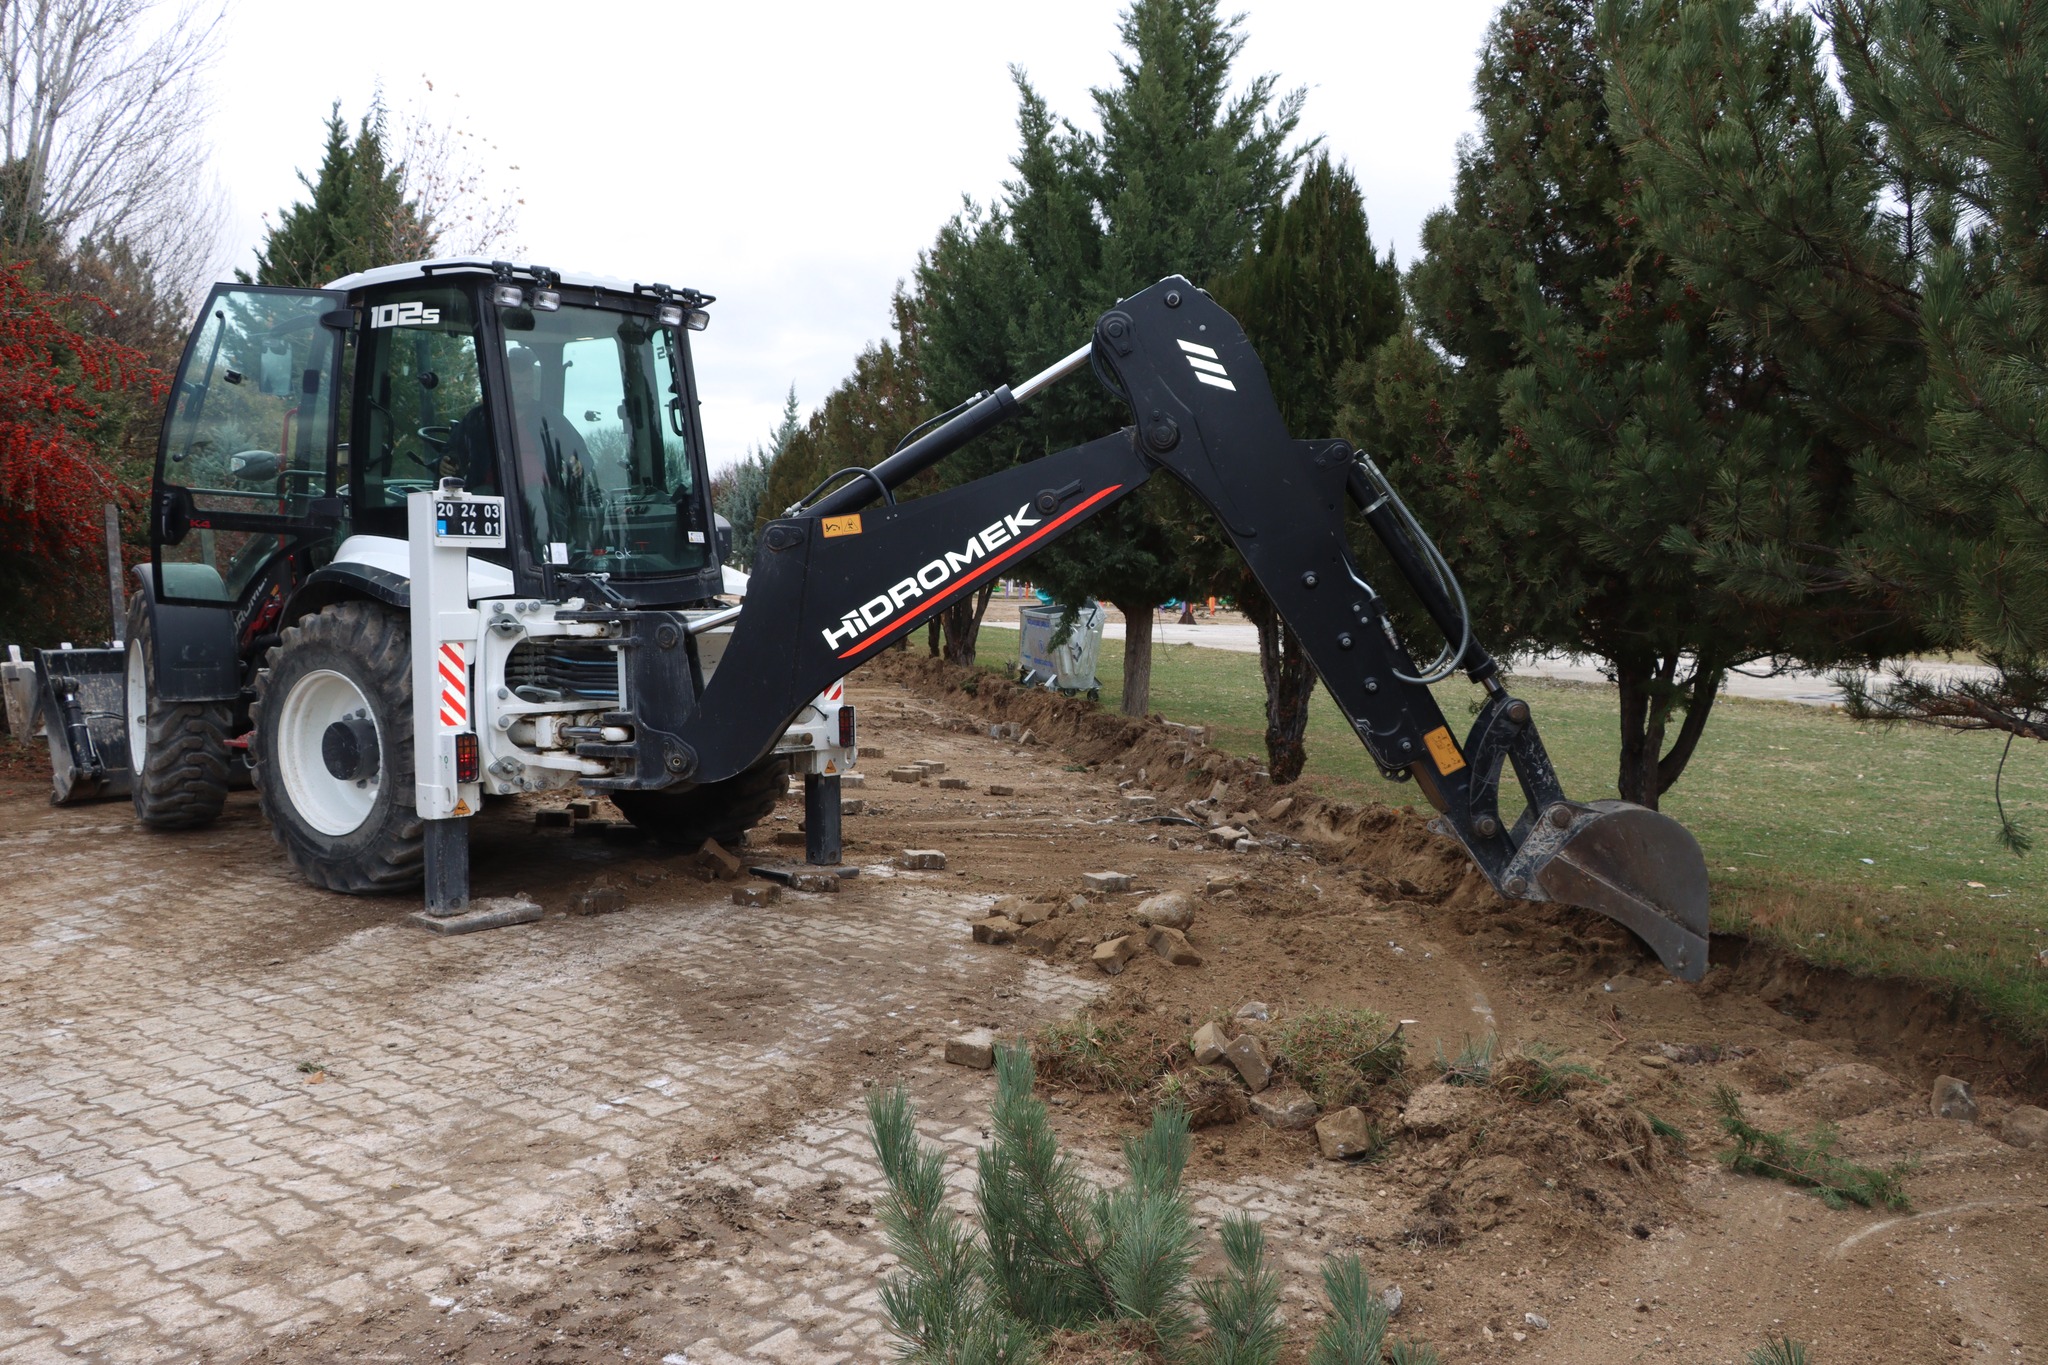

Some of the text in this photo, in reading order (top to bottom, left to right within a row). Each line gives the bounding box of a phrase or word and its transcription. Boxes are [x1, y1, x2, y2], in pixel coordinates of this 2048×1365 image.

[437, 503, 500, 518] 20 24 03
[461, 521, 499, 535] 14 01
